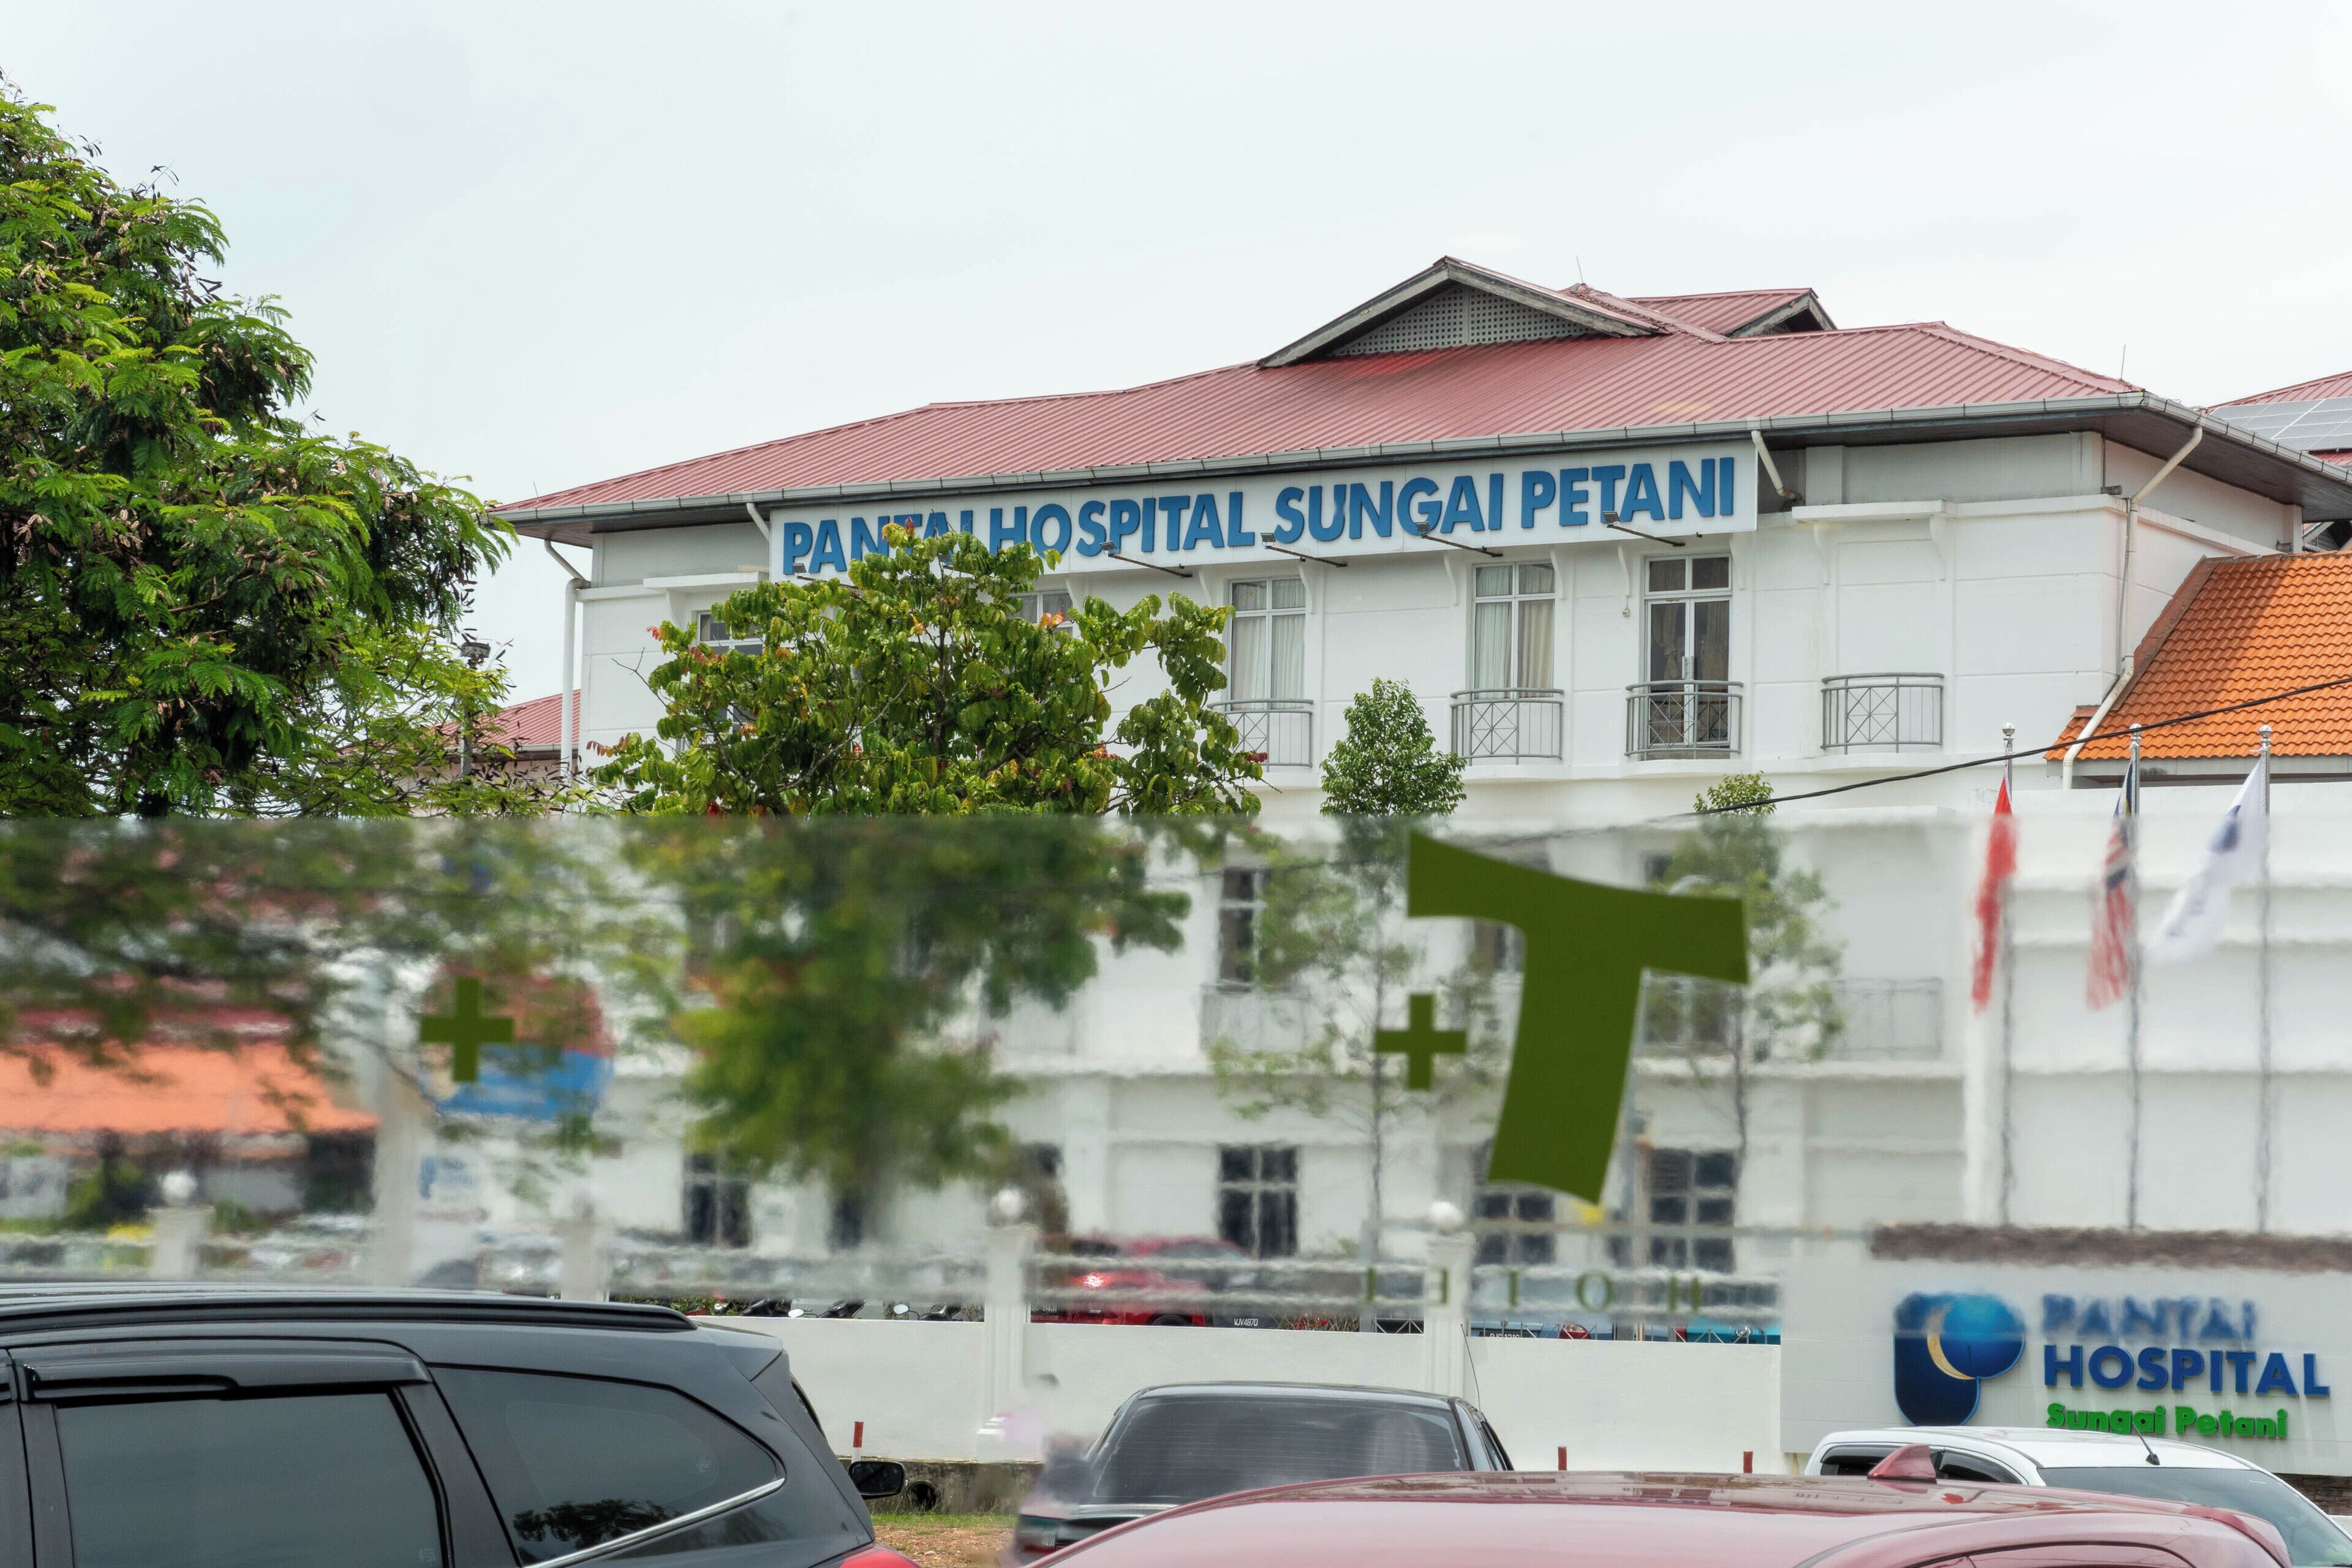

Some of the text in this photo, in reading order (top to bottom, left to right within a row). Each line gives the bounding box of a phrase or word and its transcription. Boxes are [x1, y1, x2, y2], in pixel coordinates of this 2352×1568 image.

[989, 491, 1255, 559] HOSPITAL
[1275, 473, 1504, 544] SUNGAI
[1521, 457, 1735, 529] PETANI
[2041, 1293, 2256, 1341] PANTAI
[2043, 1344, 2331, 1396] HOSPITAL
[2046, 1402, 2289, 1439] Sungai Petani
